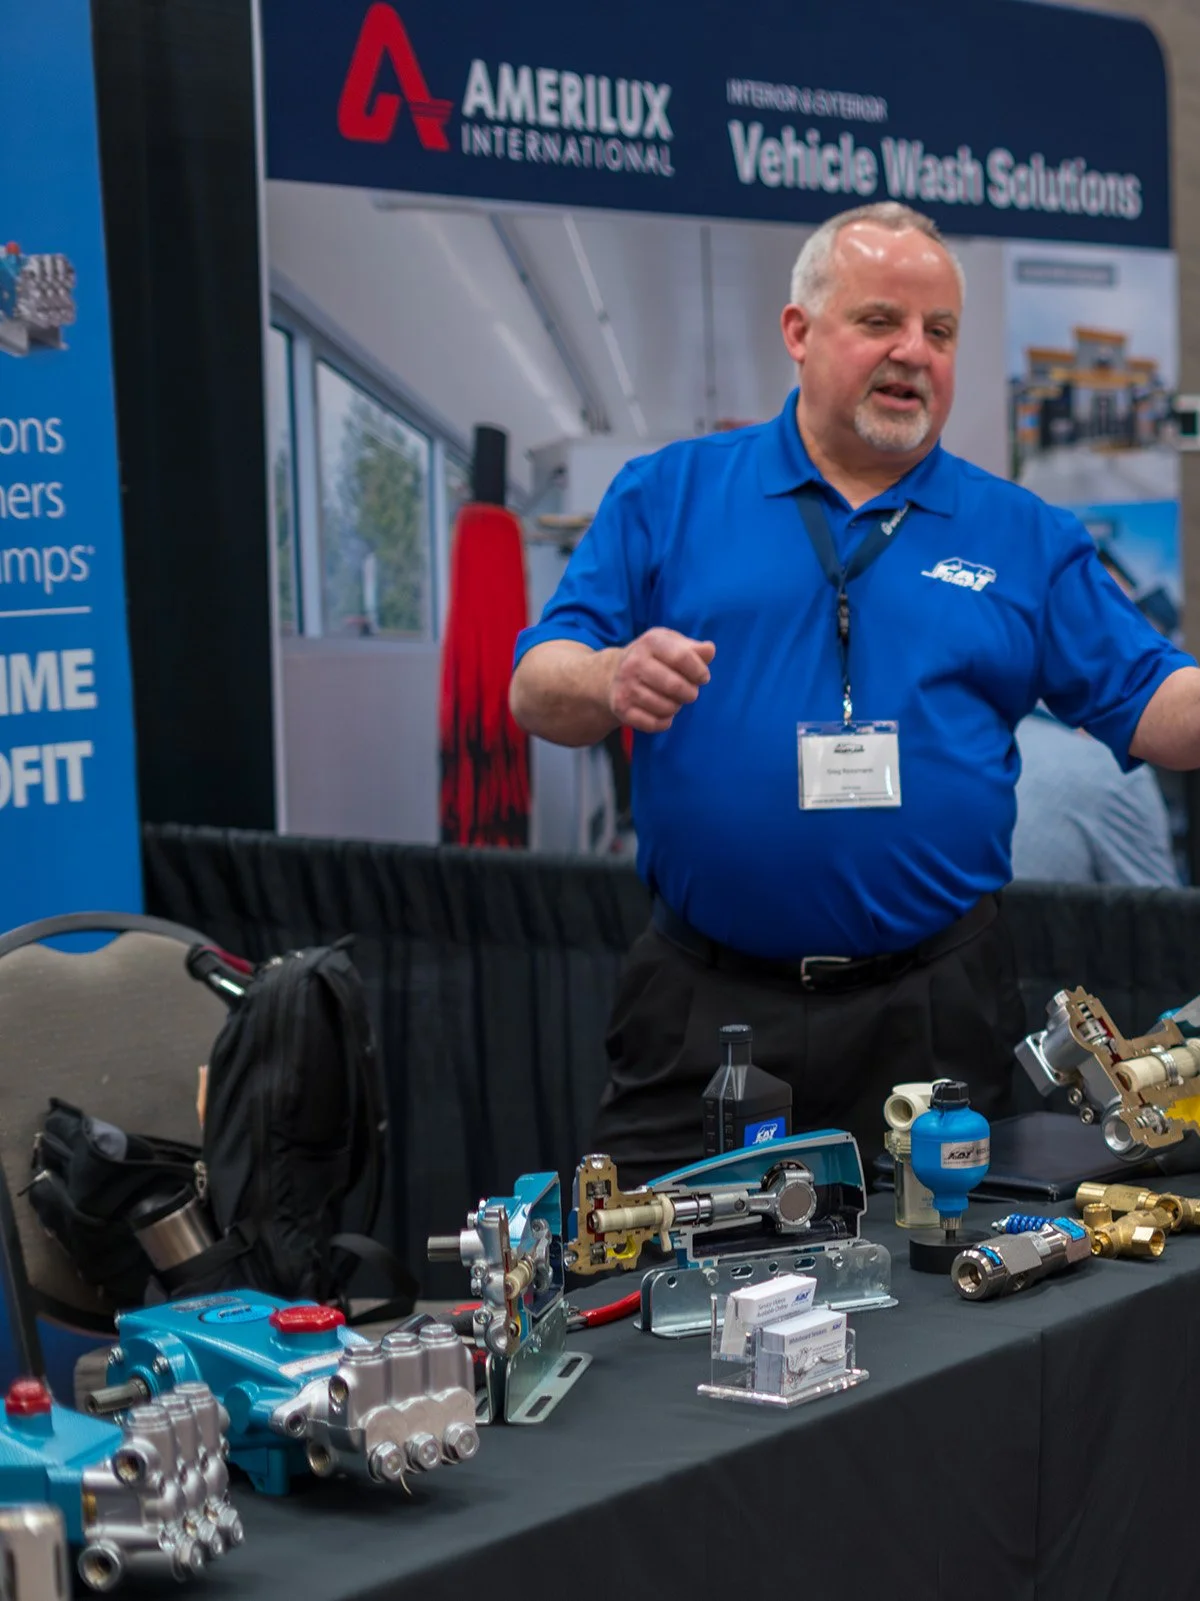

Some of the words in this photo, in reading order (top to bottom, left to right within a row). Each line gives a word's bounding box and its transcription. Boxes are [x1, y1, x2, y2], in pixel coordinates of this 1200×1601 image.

[461, 58, 673, 141] AMERILUX
[461, 122, 676, 177] INTERNATIONAL
[728, 119, 878, 197] Vehicle
[881, 136, 984, 206] Wash
[987, 147, 1143, 220] Solutions
[0, 544, 92, 595] mps
